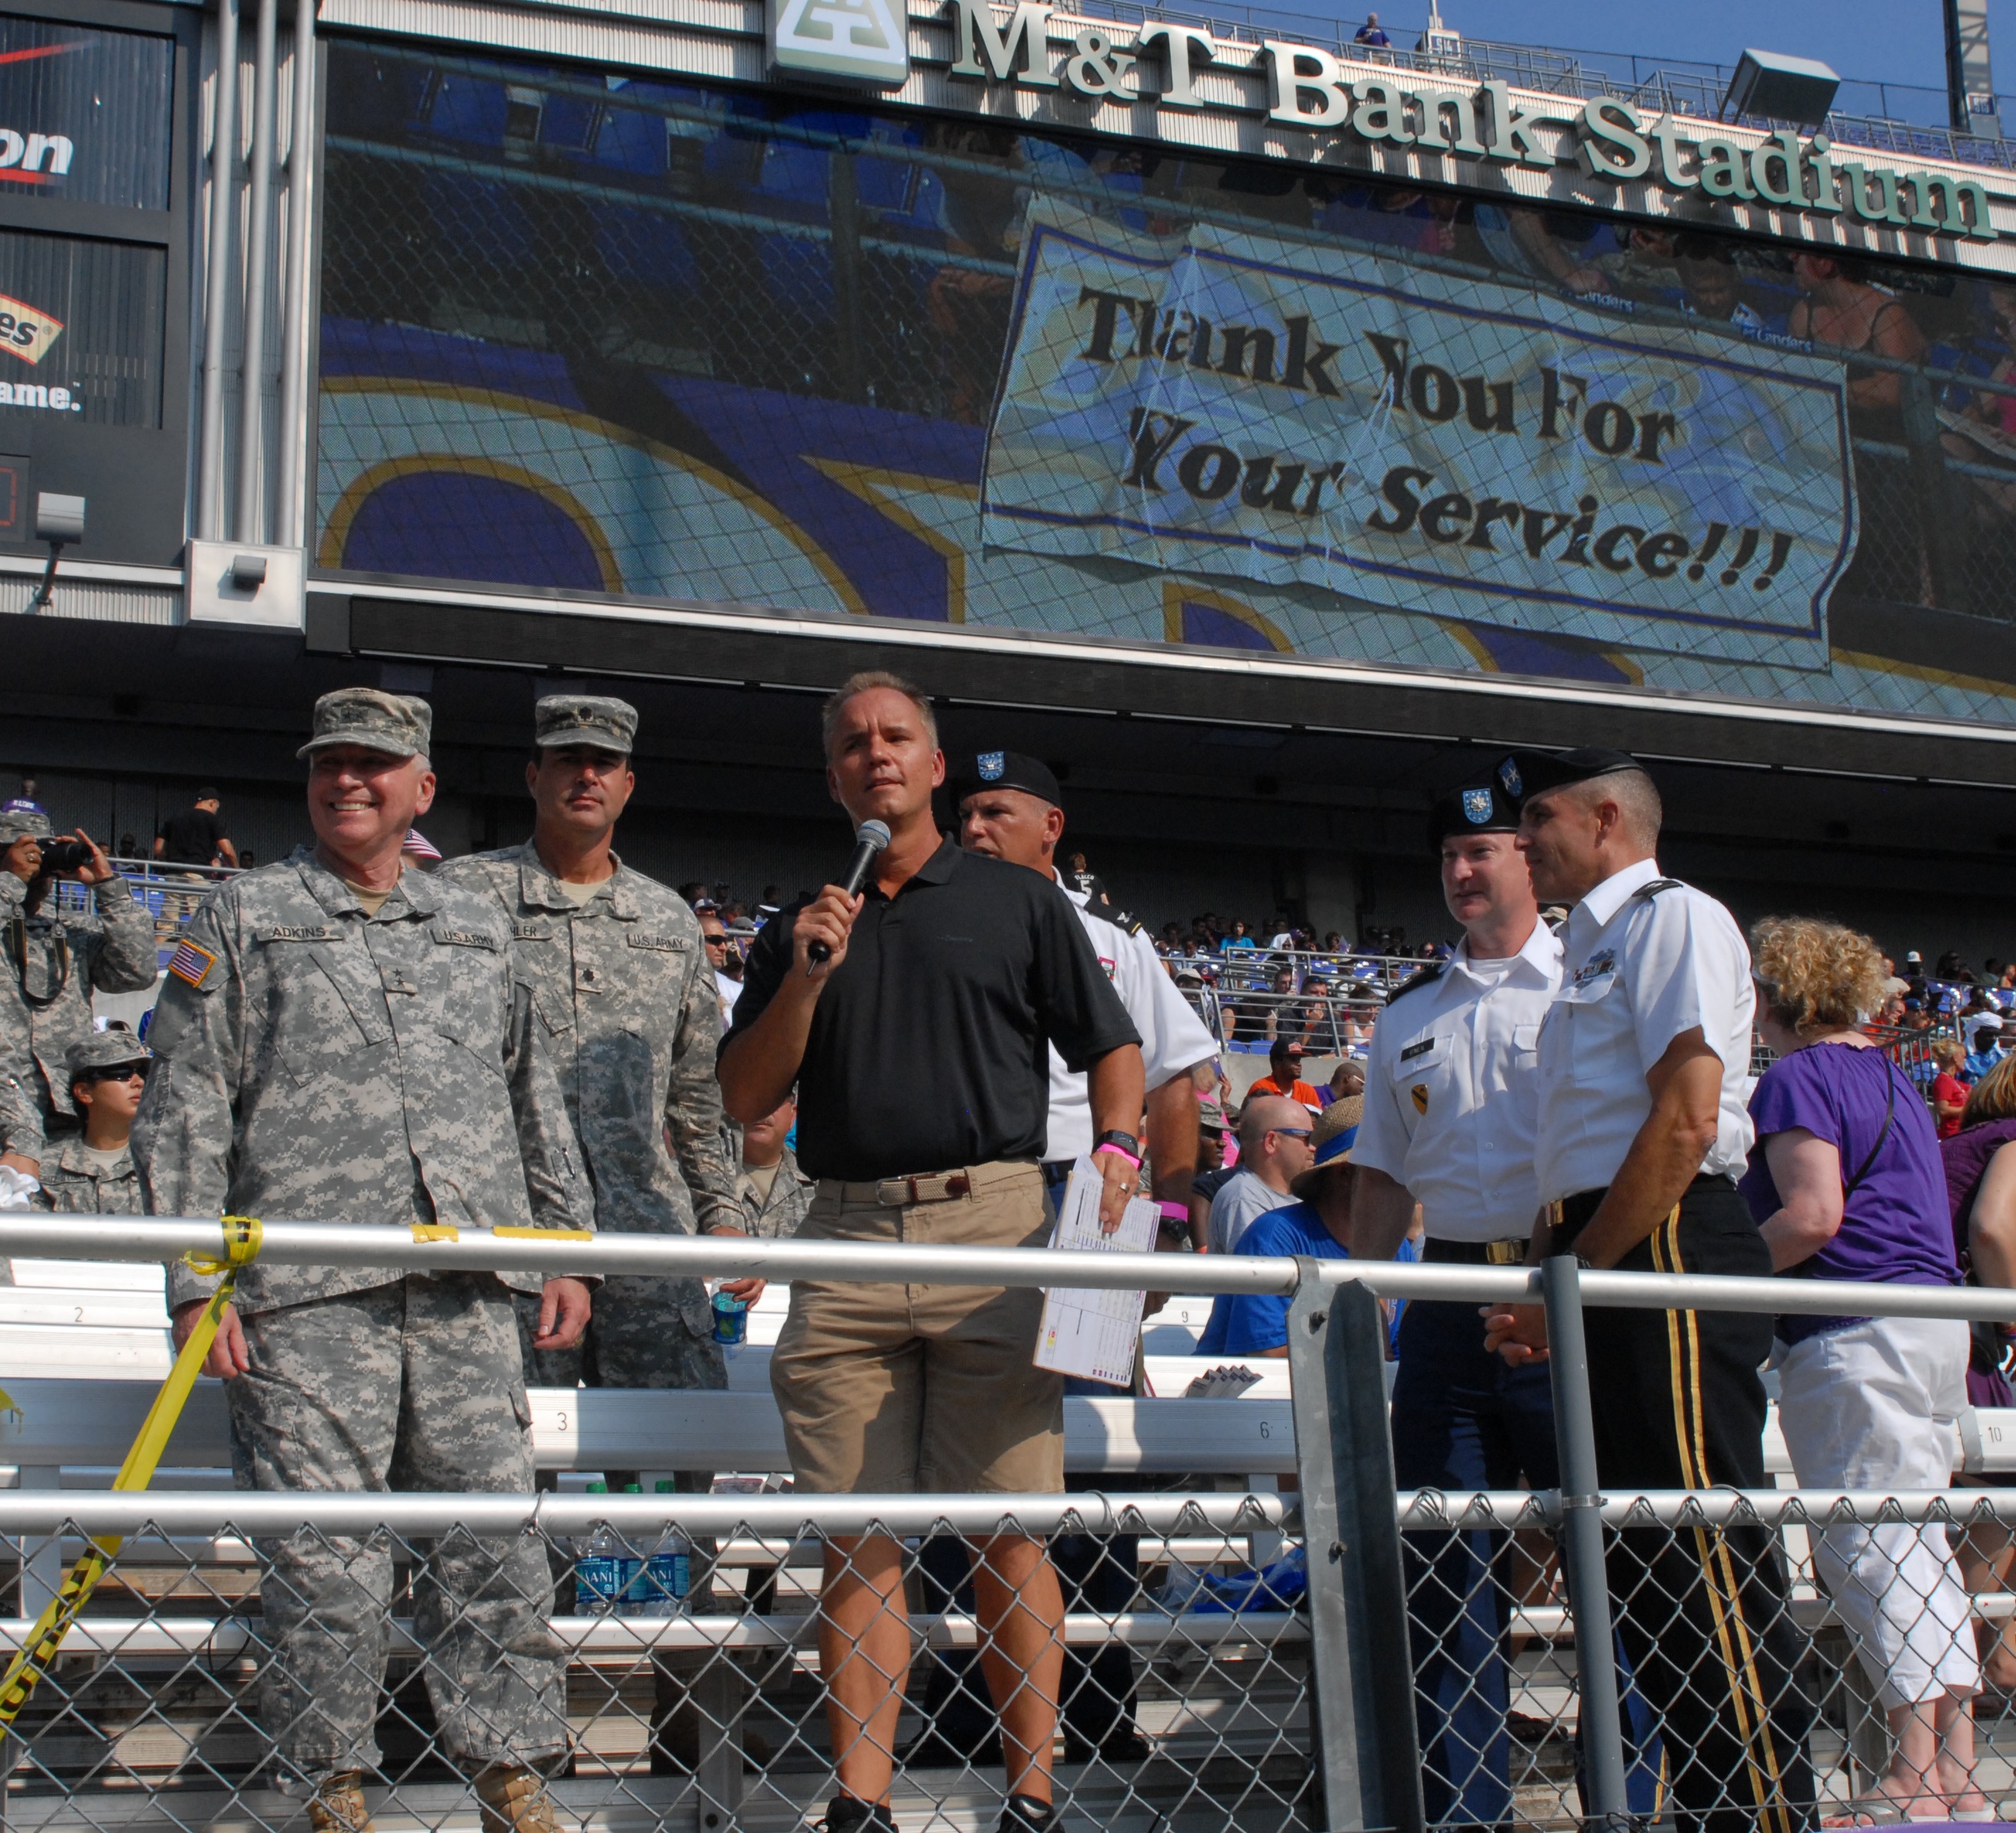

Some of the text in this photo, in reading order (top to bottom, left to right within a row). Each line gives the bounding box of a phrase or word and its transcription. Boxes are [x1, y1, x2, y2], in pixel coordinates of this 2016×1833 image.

[951, 0, 1999, 240] M&T Bank Stadium
[1363, 330, 1520, 436] You
[1536, 366, 1676, 466] For
[1122, 406, 1795, 591] Your Service!!!
[1080, 880, 1092, 898] 5
[272, 927, 326, 938] ADKINS
[634, 934, 683, 949] U.S. ARMY
[74, 1307, 83, 1322] 2
[1181, 1310, 1188, 1323] 9
[557, 1412, 567, 1431] 3
[1260, 1421, 1270, 1439] 6
[1988, 1426, 2002, 1443] 10
